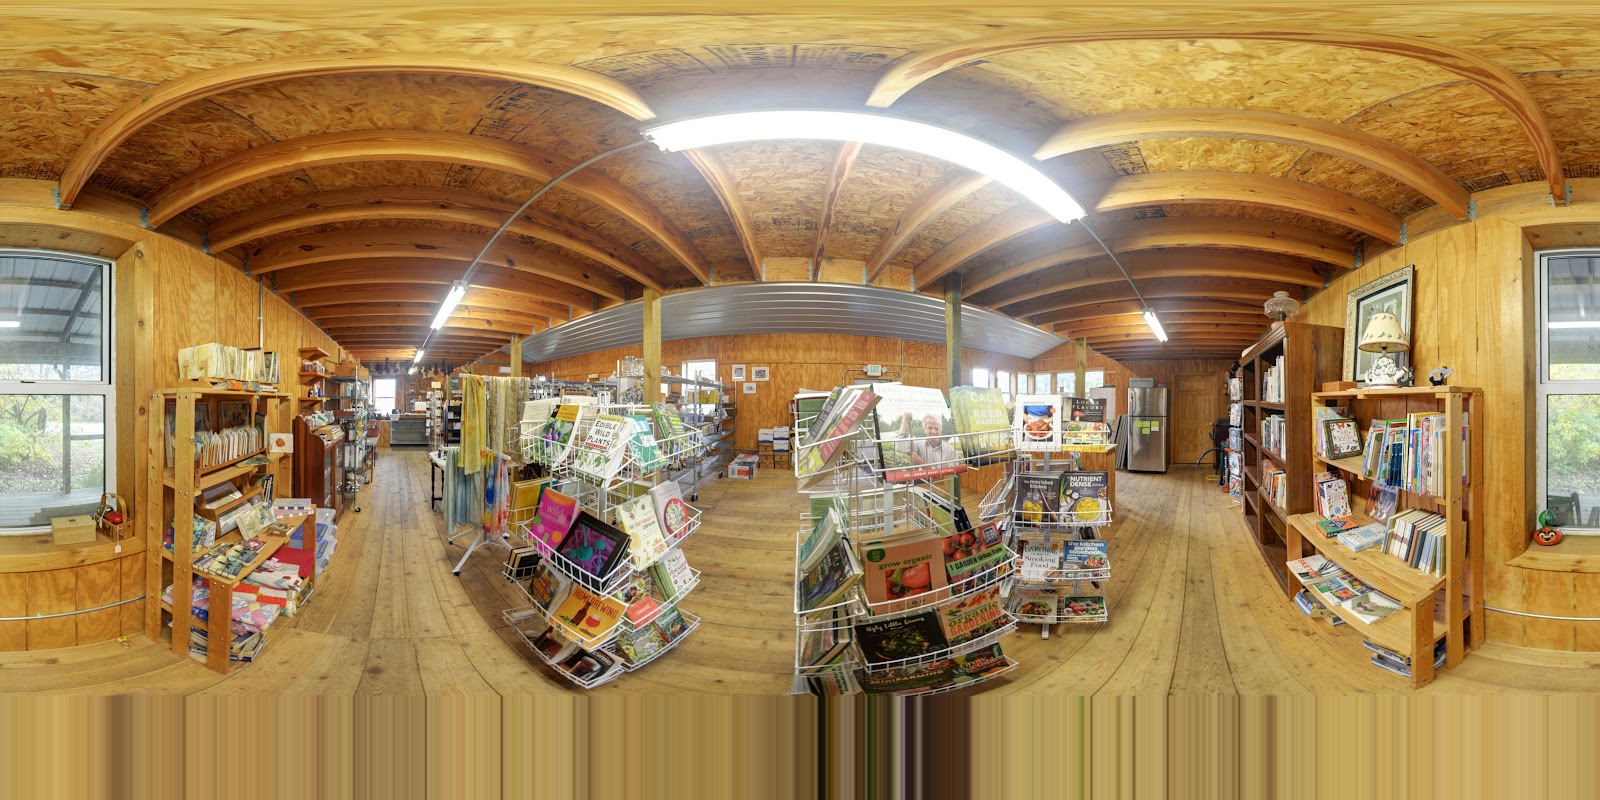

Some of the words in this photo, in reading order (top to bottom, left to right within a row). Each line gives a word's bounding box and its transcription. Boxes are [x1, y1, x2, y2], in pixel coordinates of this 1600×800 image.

[970, 392, 1000, 403] CALL
[973, 408, 1003, 418] REED
[595, 420, 618, 430] EDIBLE
[595, 428, 611, 438] WILD
[587, 435, 611, 447] PLANTS
[547, 504, 565, 516] wild
[1025, 546, 1058, 555] EVERYTHING
[878, 561, 901, 571] grow
[903, 553, 933, 565] organic
[955, 558, 977, 570] GARDEN
[533, 576, 551, 603] BREW
[573, 587, 619, 620] HOMEBREWING
[948, 601, 999, 628] organic
[866, 623, 883, 633] Ugly
[884, 621, 902, 630] Little
[904, 617, 925, 626] Greens
[950, 607, 1001, 637] GARDENING
